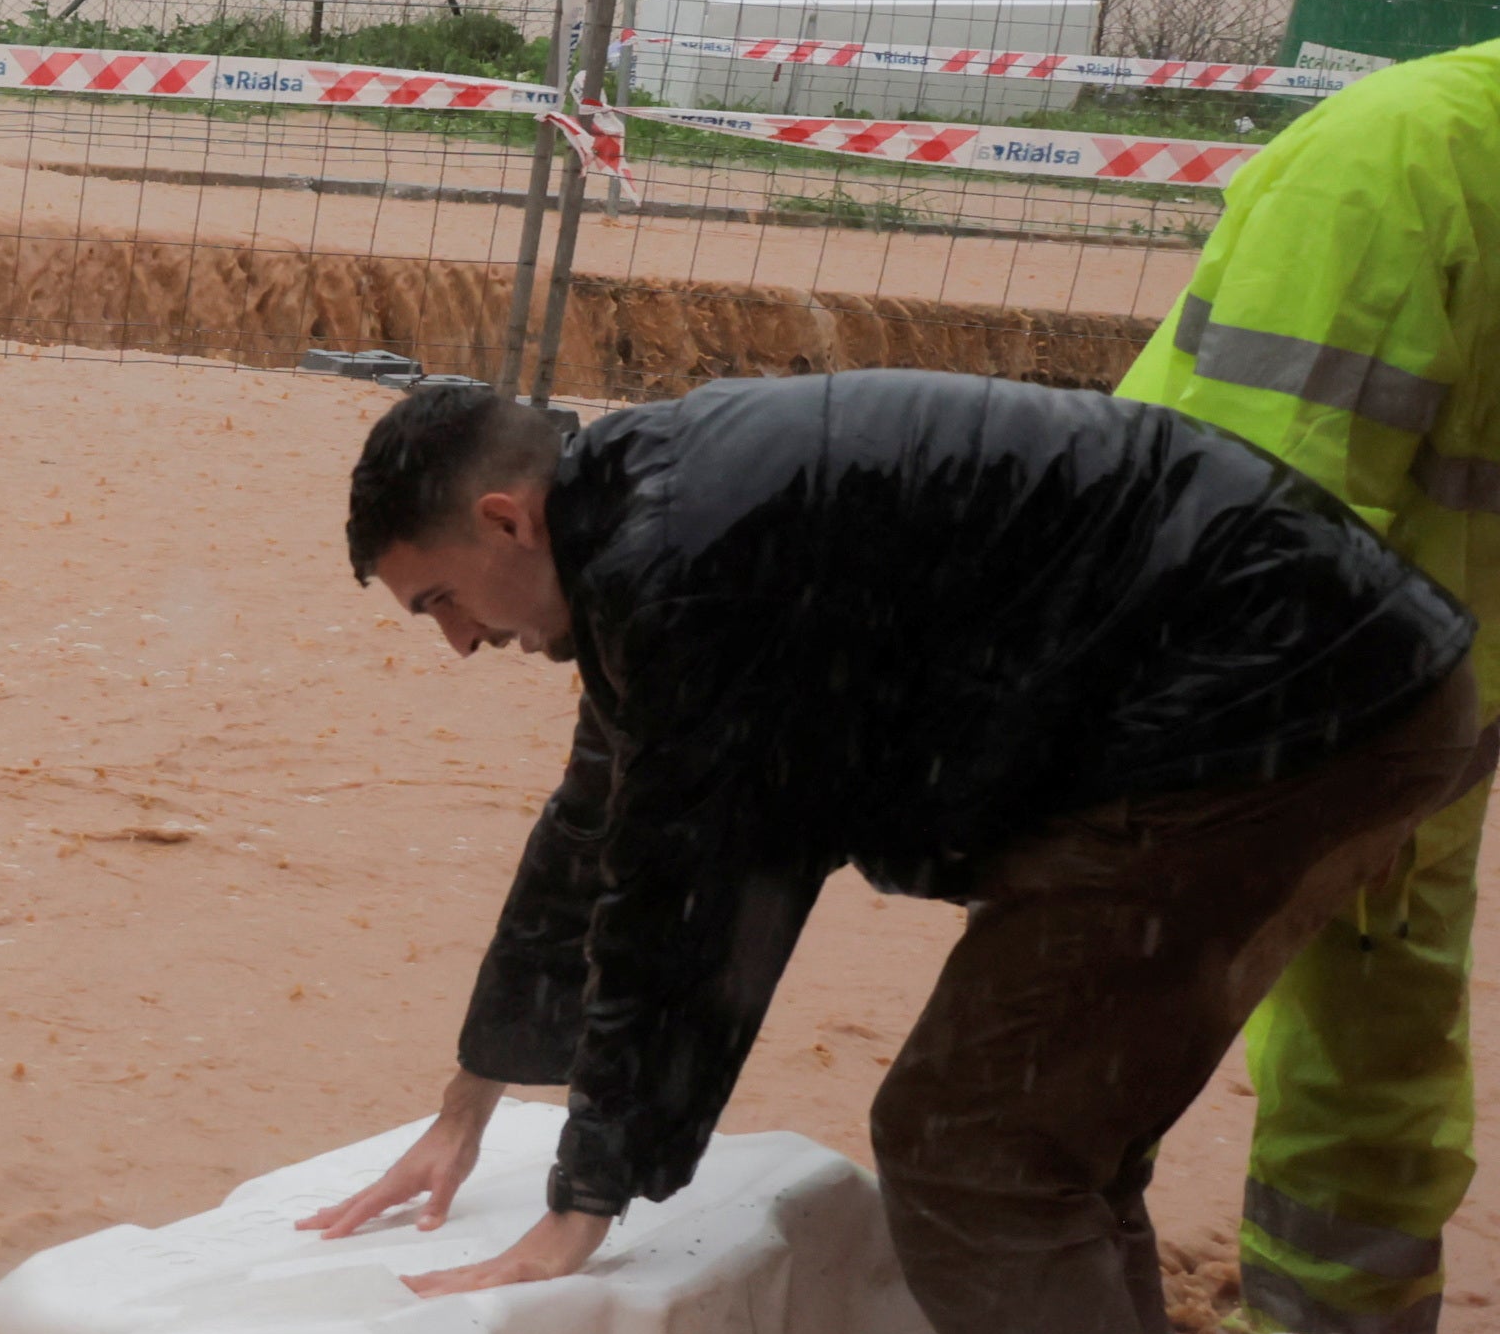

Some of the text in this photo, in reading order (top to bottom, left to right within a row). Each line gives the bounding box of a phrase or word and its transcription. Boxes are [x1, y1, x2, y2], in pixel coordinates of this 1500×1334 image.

[882, 50, 929, 66] Rialsa
[1086, 62, 1132, 78] Rialsa
[236, 69, 304, 93] Rialsa
[1297, 74, 1345, 91] Rialsa
[1007, 141, 1081, 166] Rialsa
